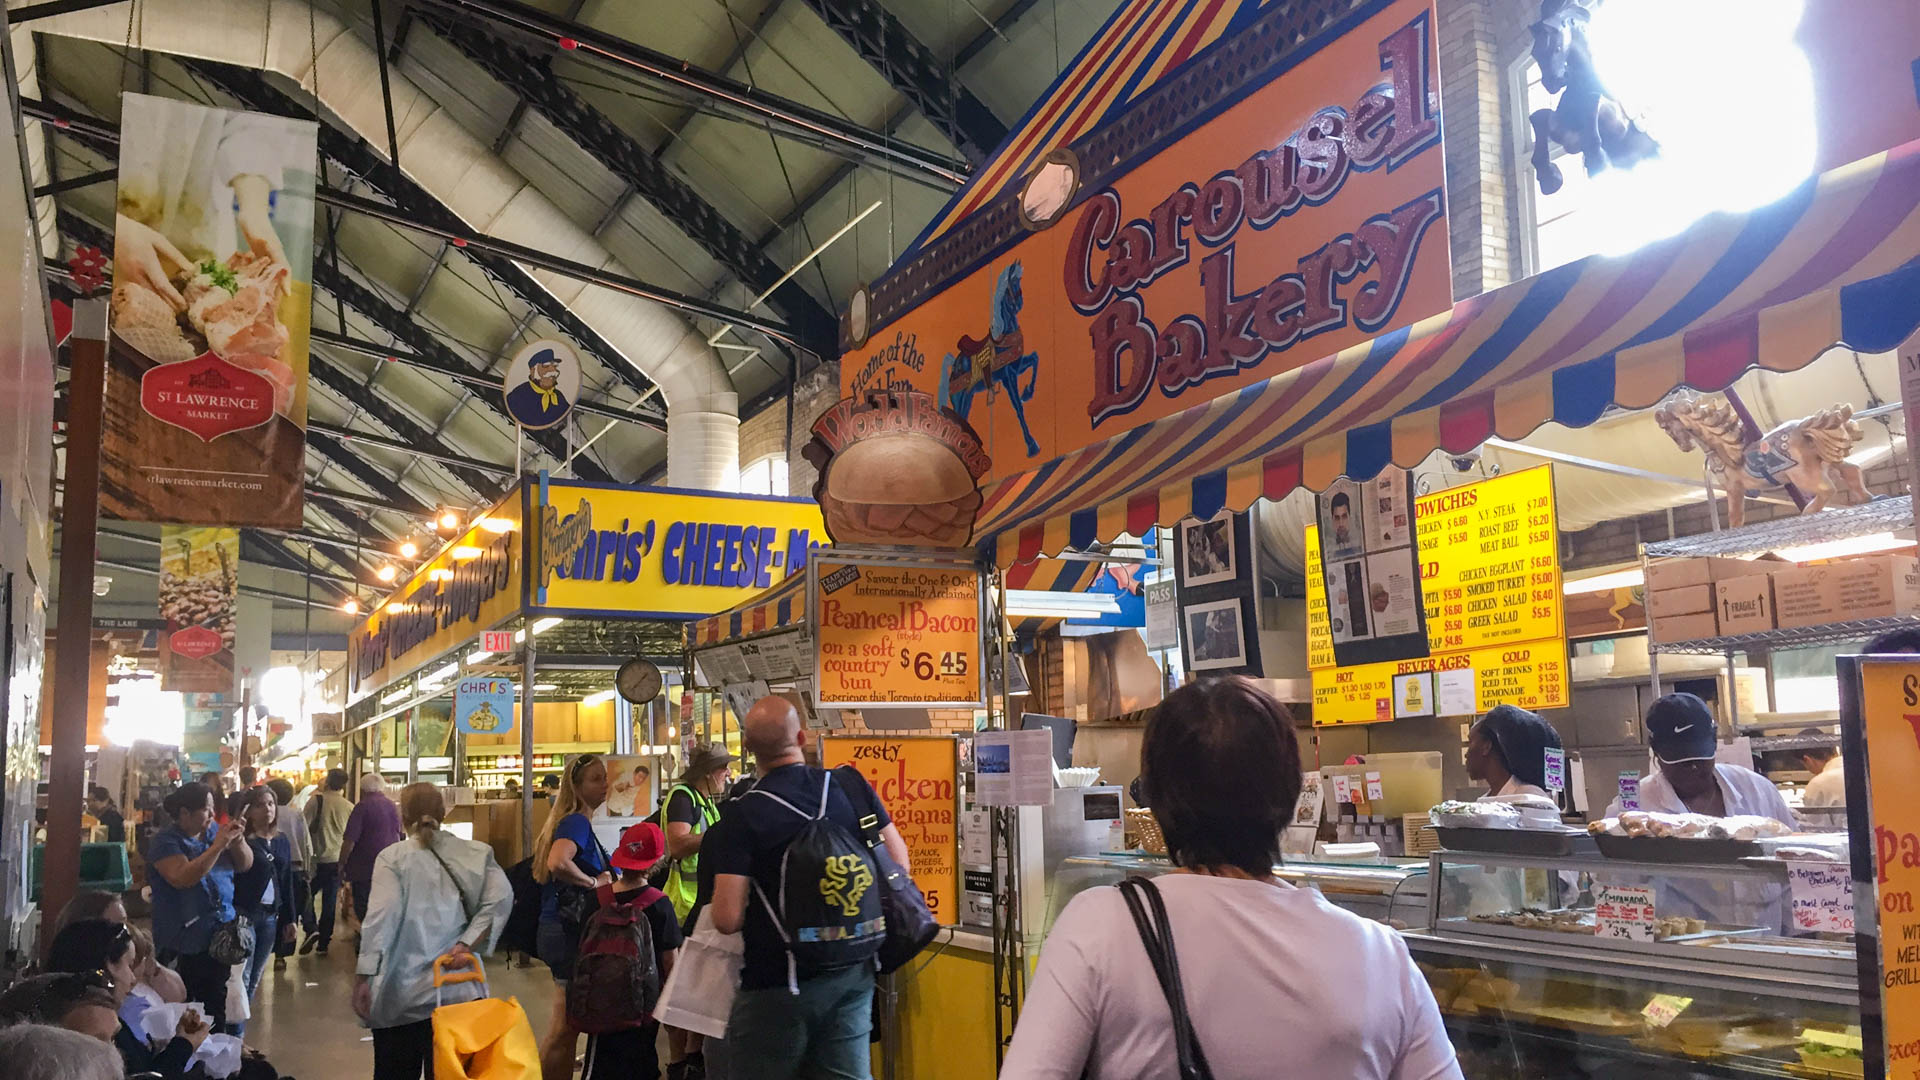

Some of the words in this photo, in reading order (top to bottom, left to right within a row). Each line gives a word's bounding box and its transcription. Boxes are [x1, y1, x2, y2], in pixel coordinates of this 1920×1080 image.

[1064, 9, 1442, 316] Carousel
[1087, 188, 1443, 429] Bakery
[850, 349, 886, 397] Home
[887, 331, 903, 362] of
[903, 333, 925, 374] the
[176, 392, 259, 410] LAWRENCE
[186, 410, 230, 420] MARKET
[812, 392, 909, 452] World
[910, 391, 992, 478] Famous
[1415, 489, 1478, 518] DWICHES
[1493, 503, 1517, 519] STEAK
[1479, 524, 1501, 538] ROAST
[1503, 519, 1520, 532] BEEF
[1419, 537, 1439, 551] USAGE
[1480, 540, 1499, 554] MEAT
[1501, 535, 1520, 550] BALL
[865, 570, 899, 585] Savour
[902, 571, 917, 585] the
[918, 574, 939, 586] One
[940, 574, 950, 586] &
[951, 575, 977, 589] Only
[1459, 567, 1487, 582] CHICKEN
[1489, 559, 1525, 577] EGGPLANT
[855, 583, 927, 599] Internationally
[928, 586, 977, 600] Acclaimed
[1149, 587, 1171, 604] PASS
[1467, 581, 1495, 597] SMOKED
[1497, 575, 1526, 592] TURKEY
[1467, 597, 1497, 613] CHICKEN
[1503, 592, 1527, 607] SALAD
[1731, 600, 1756, 612] FRAGILE
[821, 599, 907, 631] Peameal
[908, 601, 977, 633] Bacon
[1468, 615, 1491, 629] GREEK
[1493, 610, 1519, 626] SALAD
[485, 632, 512, 652] EXIT
[822, 642, 843, 655] on
[848, 644, 857, 656] a
[862, 635, 895, 657] soft
[824, 658, 891, 677] country
[1336, 671, 1354, 683] HOT
[1502, 650, 1530, 664] COLD
[1397, 654, 1471, 675] BEVERAGES
[1481, 668, 1500, 678] SOFT
[1503, 665, 1532, 675] DRINKS
[839, 670, 872, 690] bun
[1482, 679, 1500, 688] ICED
[1502, 677, 1518, 686] TEA
[819, 691, 867, 702] Experience
[869, 690, 887, 702] this
[888, 690, 921, 702] Toronto
[1315, 687, 1338, 696] COFFEE
[1316, 697, 1328, 705] TEA
[1482, 687, 1525, 698] LEMONADE
[853, 741, 902, 762] zesty
[922, 826, 949, 845] bun
[924, 867, 933, 875] OR
[1883, 891, 1914, 913] on
